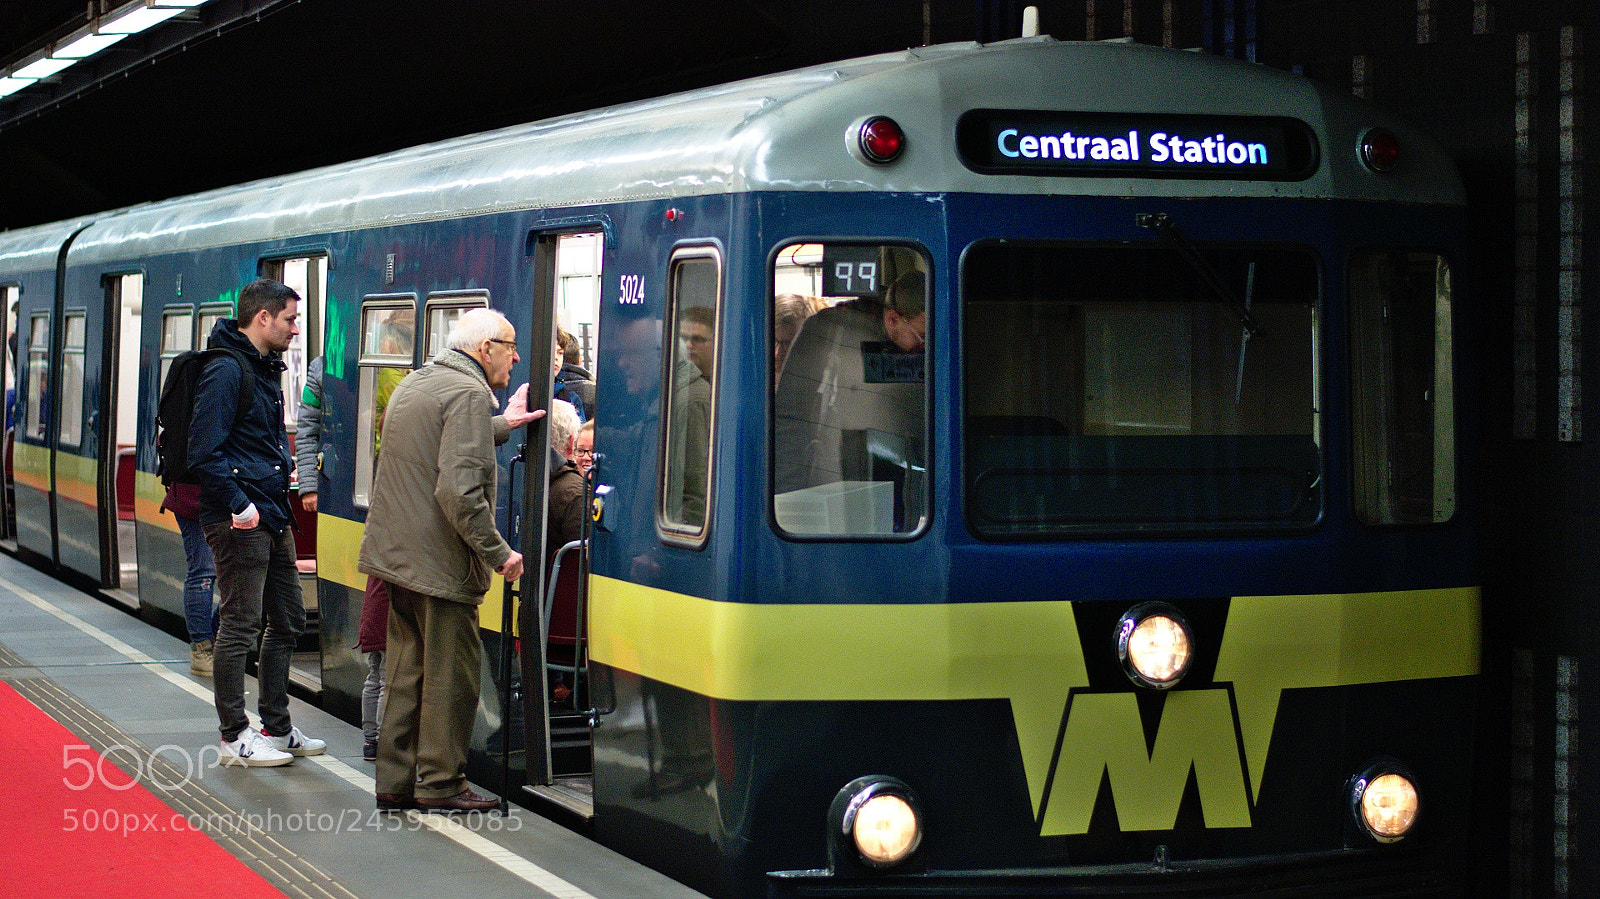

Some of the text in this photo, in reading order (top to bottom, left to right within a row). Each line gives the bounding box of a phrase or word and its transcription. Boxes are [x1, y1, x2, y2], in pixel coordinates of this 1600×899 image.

[997, 128, 1268, 165] Centraal Station
[619, 274, 645, 304] 5024
[835, 262, 876, 292] 99
[1040, 689, 1252, 836] M
